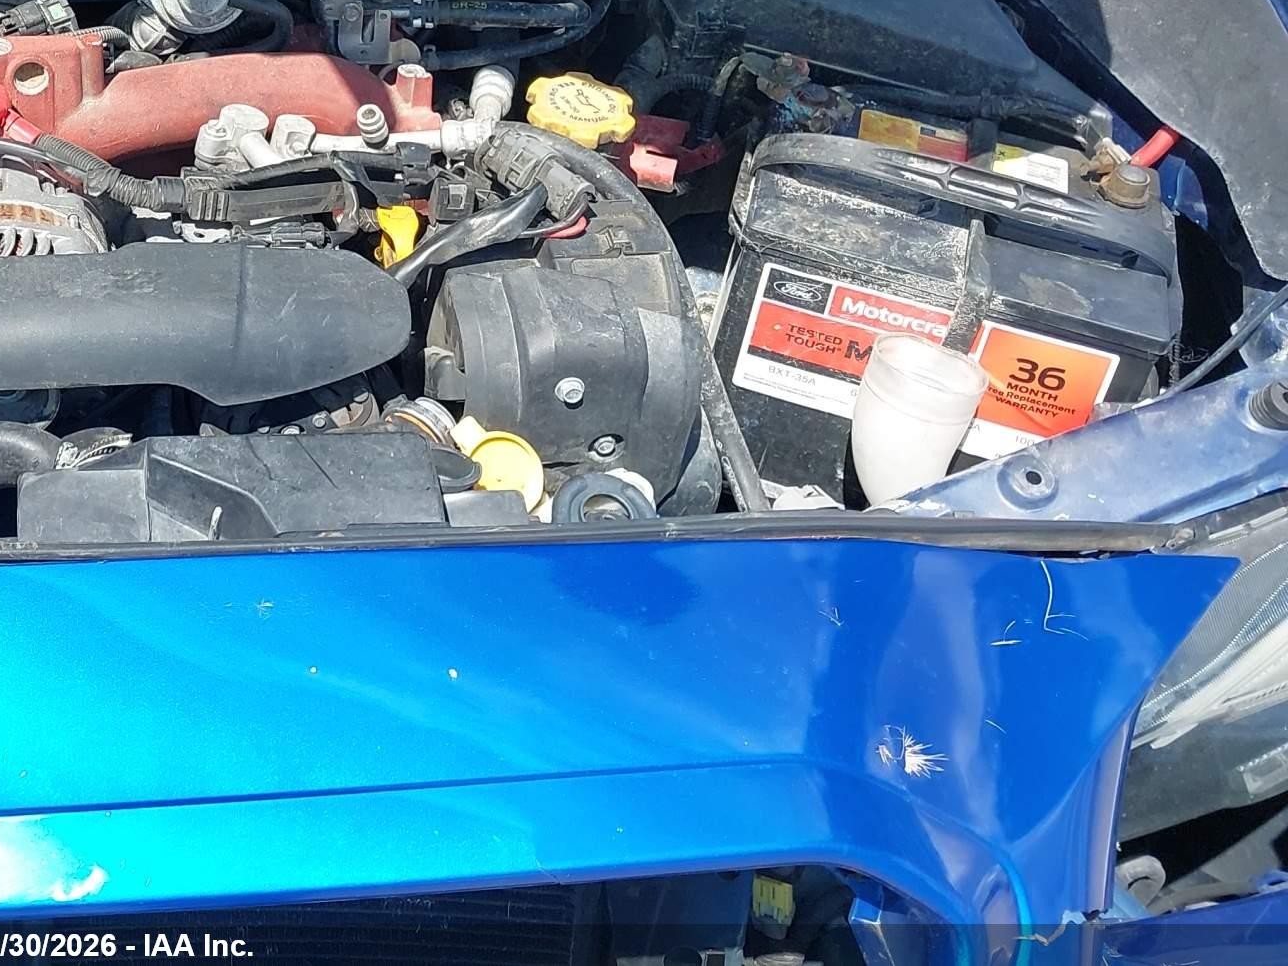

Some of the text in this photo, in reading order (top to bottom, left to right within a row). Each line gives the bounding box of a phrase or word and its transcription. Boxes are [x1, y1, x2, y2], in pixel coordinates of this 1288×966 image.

[841, 296, 947, 338] Motorcra
[788, 323, 843, 346] TESTED
[1008, 357, 1066, 392] 36
[987, 386, 1077, 415] ree Replacement
[1006, 382, 1059, 402] MONTH
[995, 396, 1060, 418] WARRANTY
